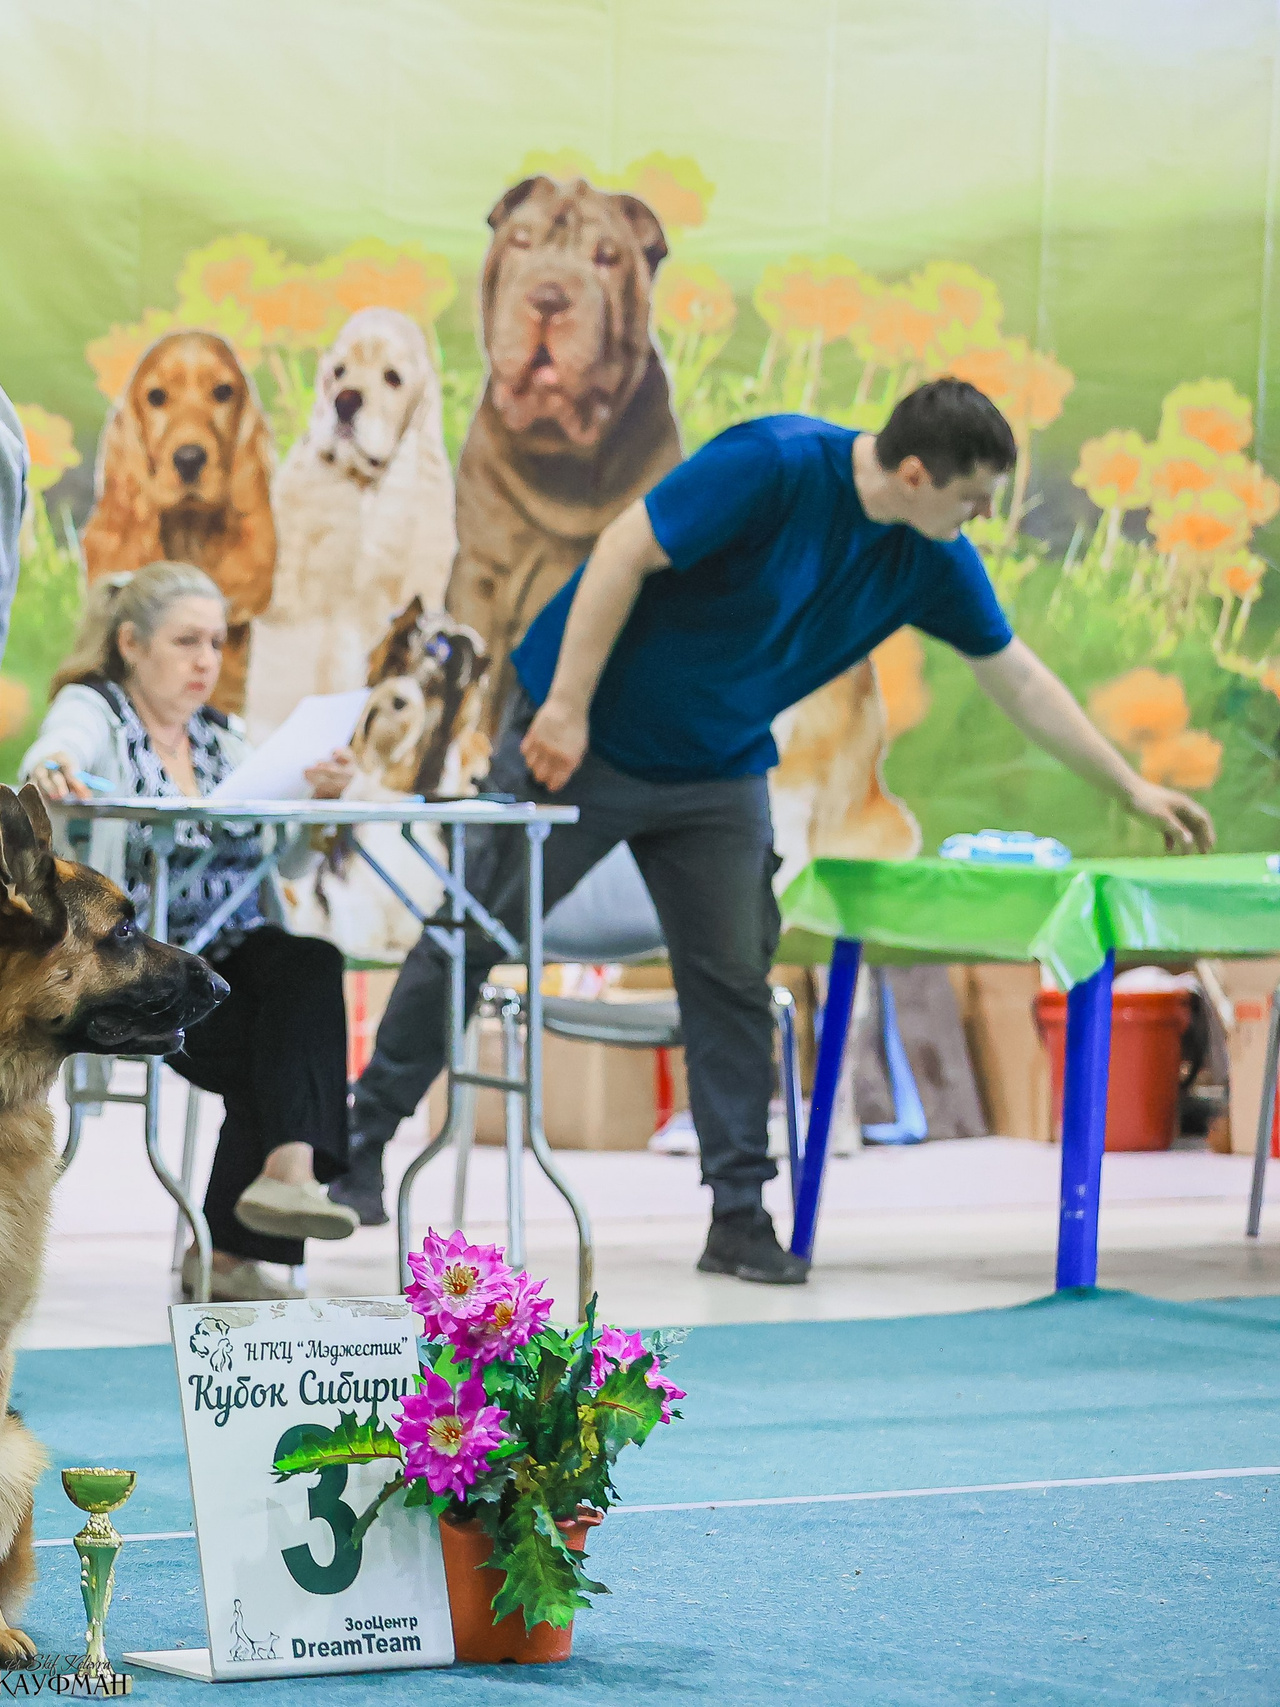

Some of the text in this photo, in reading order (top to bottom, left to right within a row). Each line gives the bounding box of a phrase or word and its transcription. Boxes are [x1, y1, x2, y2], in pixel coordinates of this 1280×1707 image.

[244, 1341, 293, 1364] НГКЦ
[188, 1369, 408, 1428] Кубок Сибири
[273, 1423, 363, 1595] 3
[291, 1633, 421, 1659] DreamTeam
